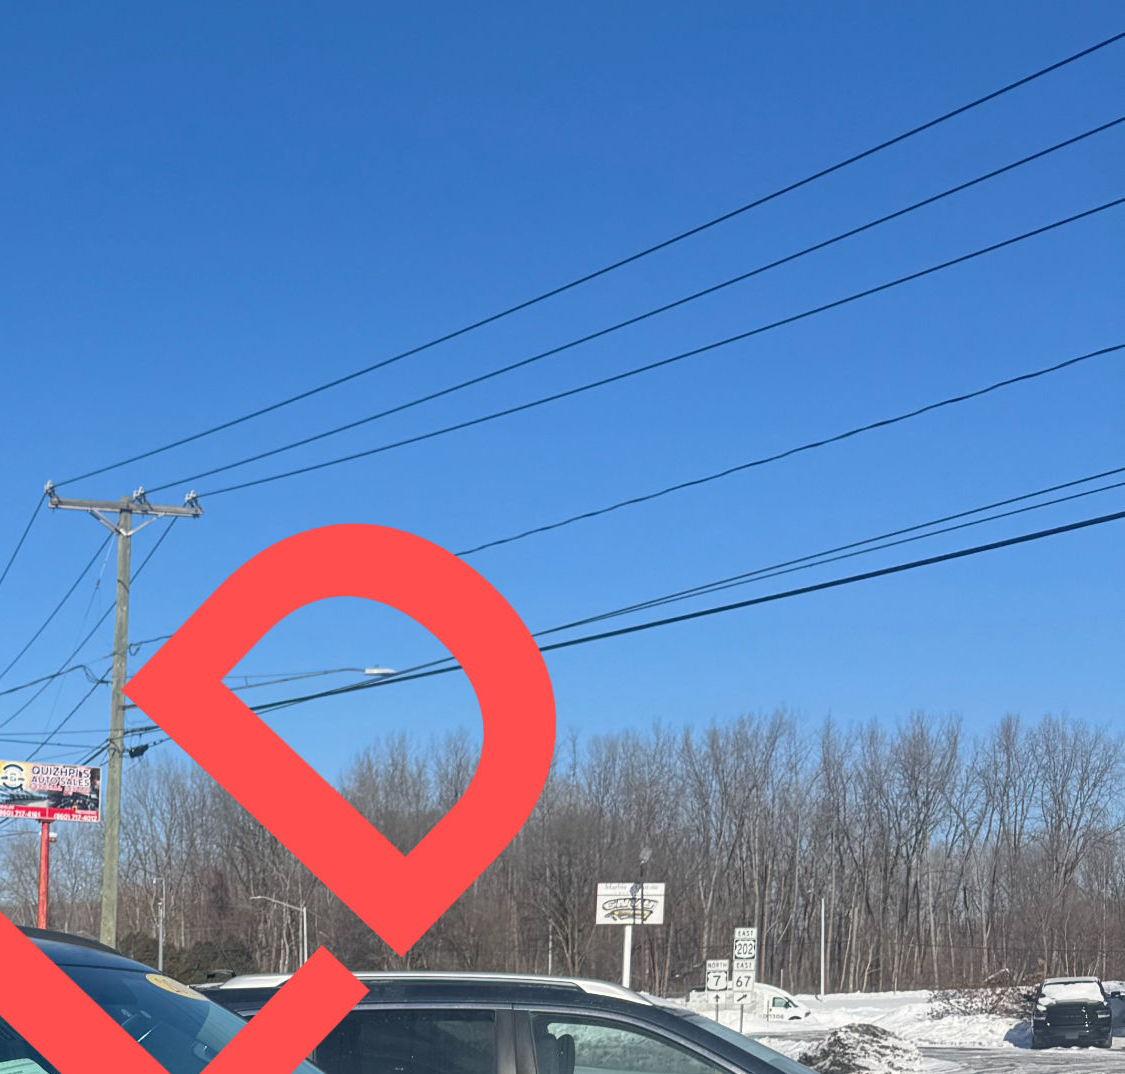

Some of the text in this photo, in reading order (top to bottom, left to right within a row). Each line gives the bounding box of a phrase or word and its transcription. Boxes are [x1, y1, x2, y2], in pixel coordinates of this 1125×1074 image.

[31, 775, 90, 787] AUTO SALES
[737, 943, 753, 955] 202
[712, 975, 721, 987] 7
[735, 975, 751, 988] 67
